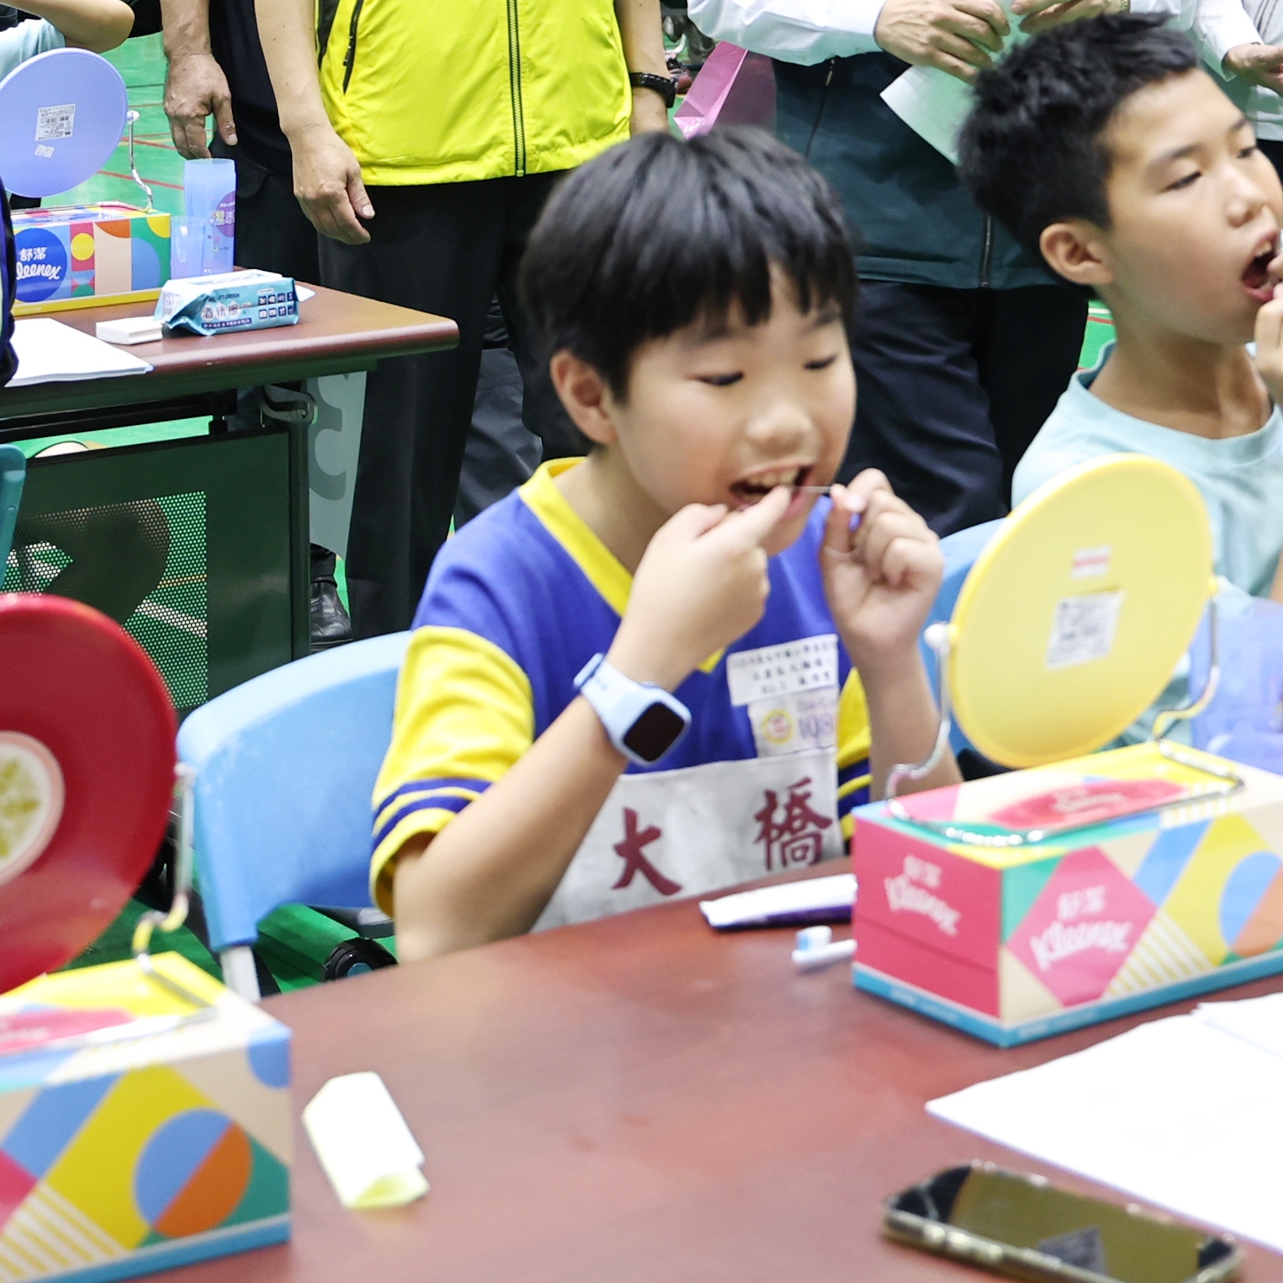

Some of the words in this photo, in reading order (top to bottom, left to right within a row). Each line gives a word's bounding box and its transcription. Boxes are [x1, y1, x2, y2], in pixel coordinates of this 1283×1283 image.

[16, 262, 62, 281] leenex
[882, 874, 962, 937] Kleenex
[1029, 920, 1133, 973] Kleenex
